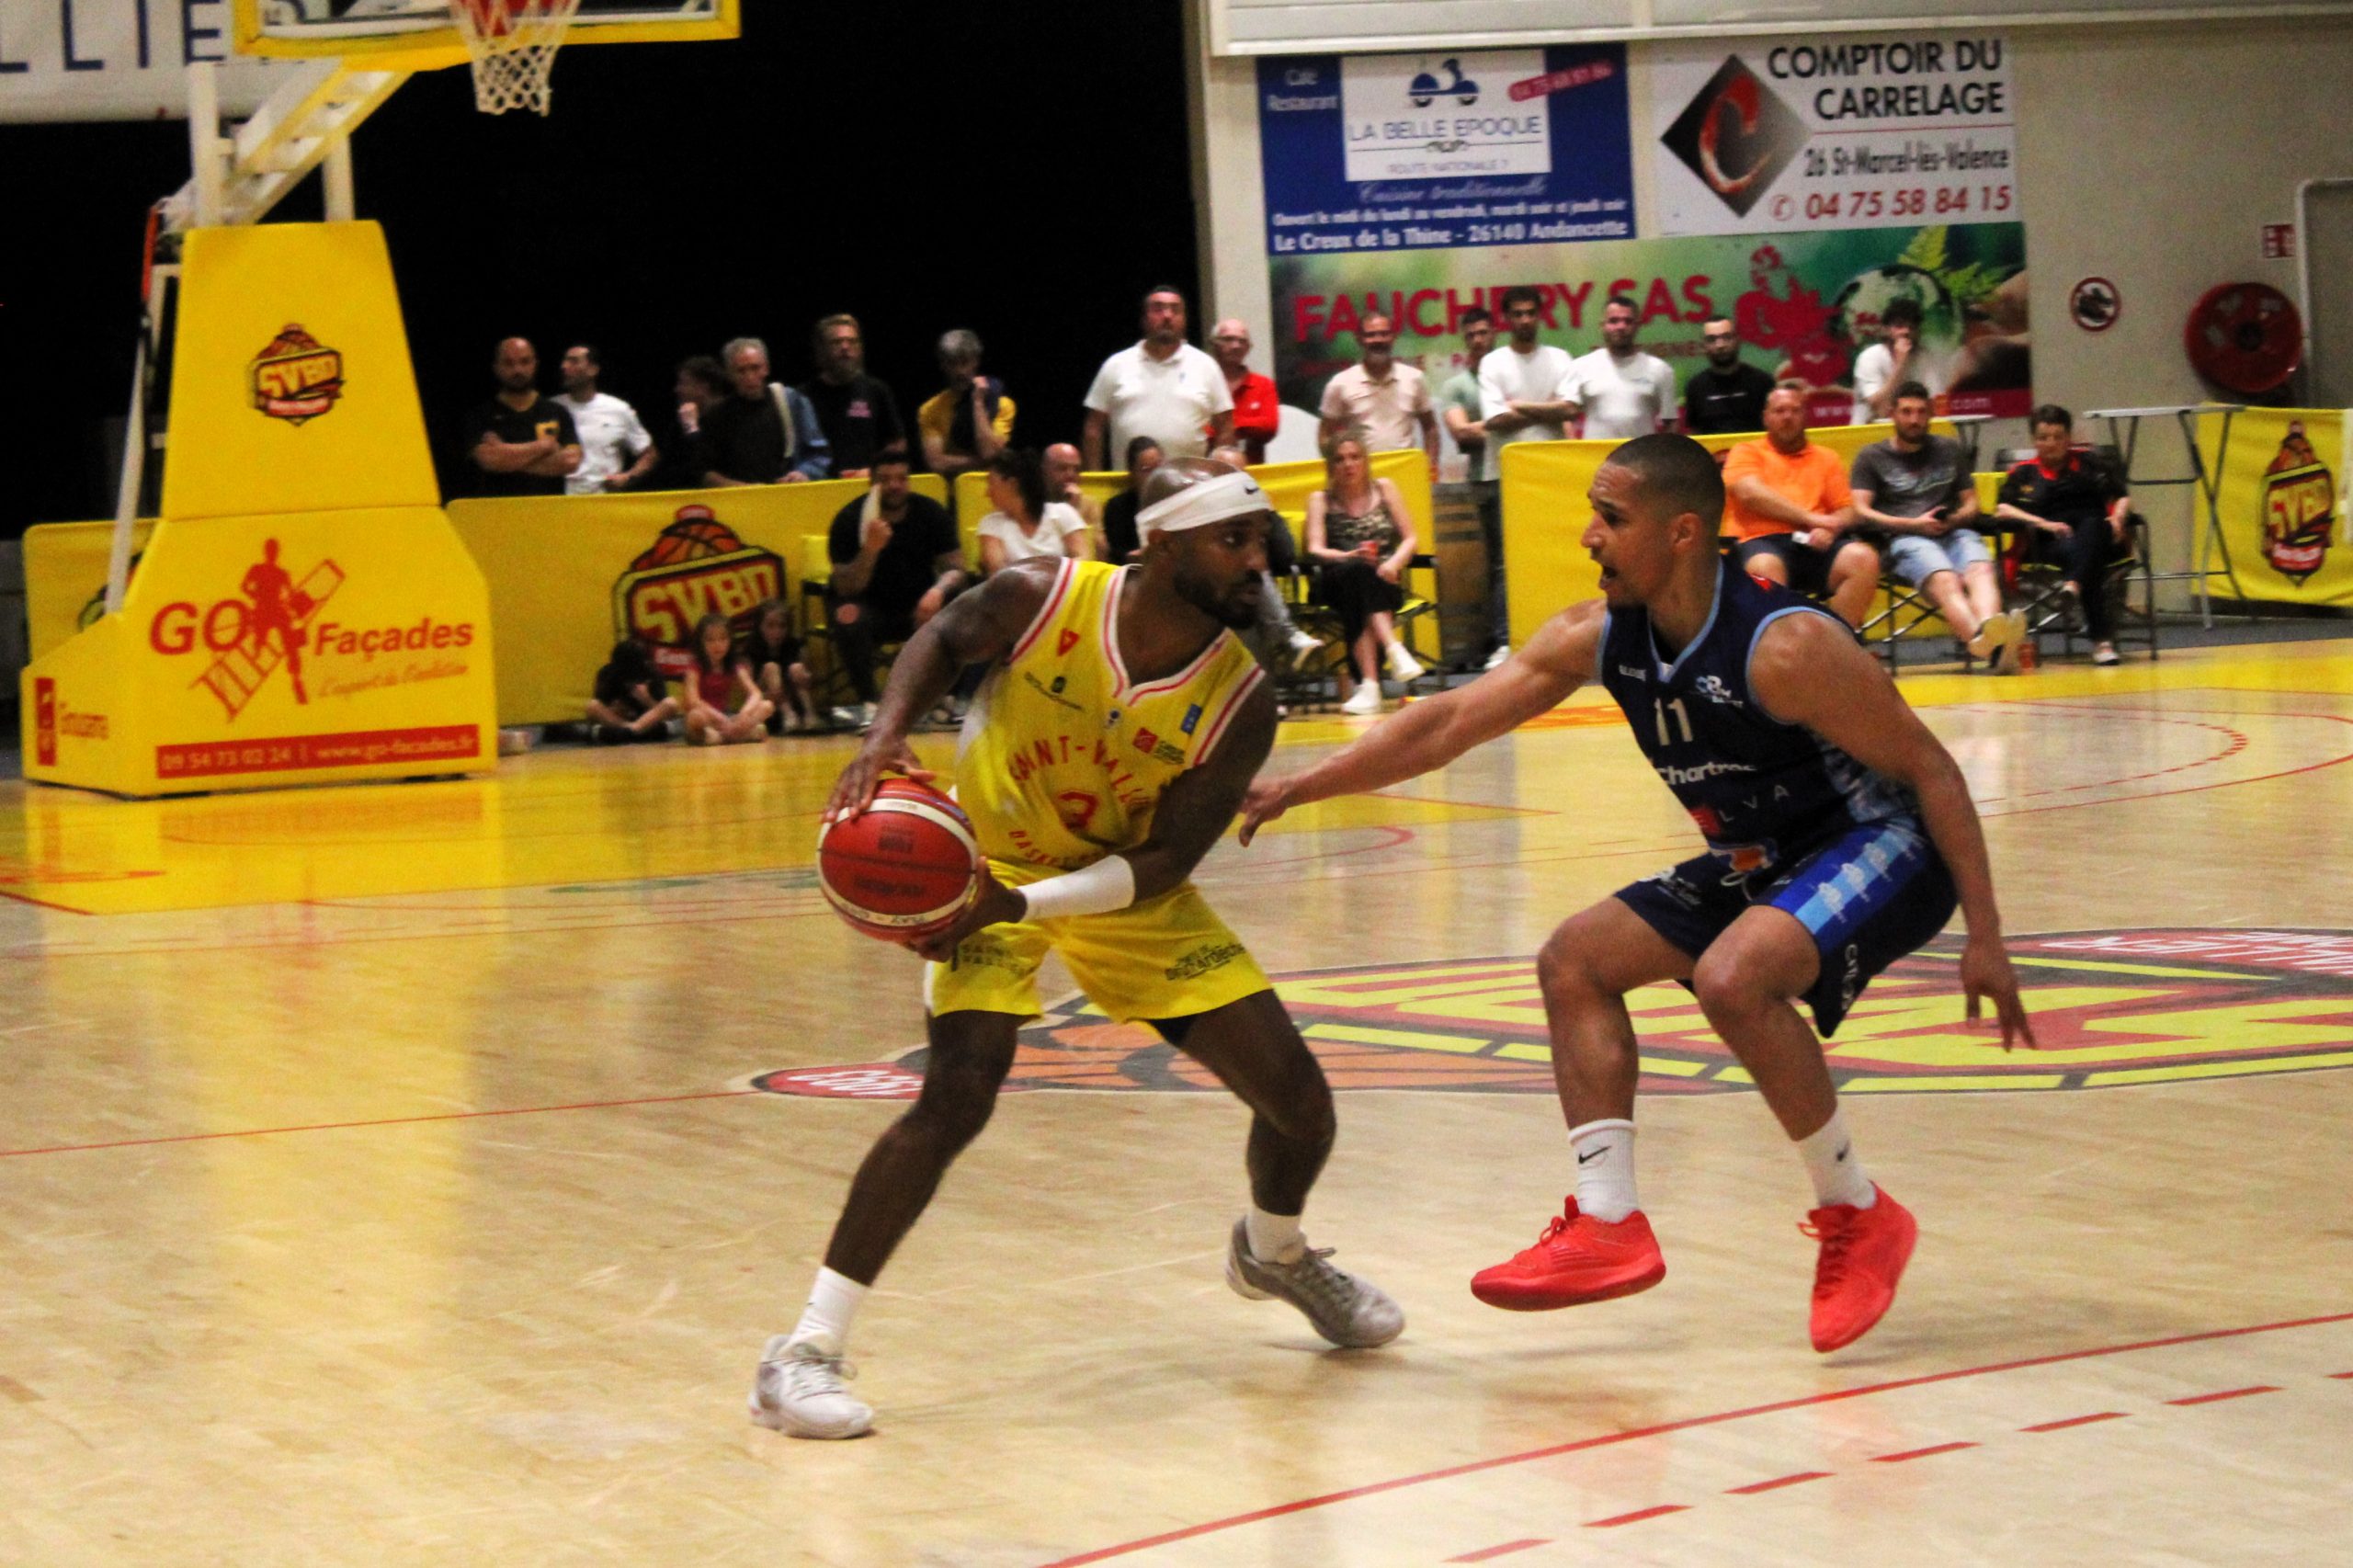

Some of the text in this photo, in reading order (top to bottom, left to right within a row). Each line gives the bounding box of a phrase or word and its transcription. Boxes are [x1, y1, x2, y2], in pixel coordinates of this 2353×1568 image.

[1768, 39, 2002, 79] COMPTOIR DU
[1813, 81, 2004, 120] CARRELAGE
[1348, 115, 1543, 142] LA BELLE EPOQUE
[1805, 185, 2012, 221] 04 75 58 84 15
[1274, 233, 1296, 252] Le
[149, 598, 474, 663] GO Façades
[1654, 698, 1693, 746] 11
